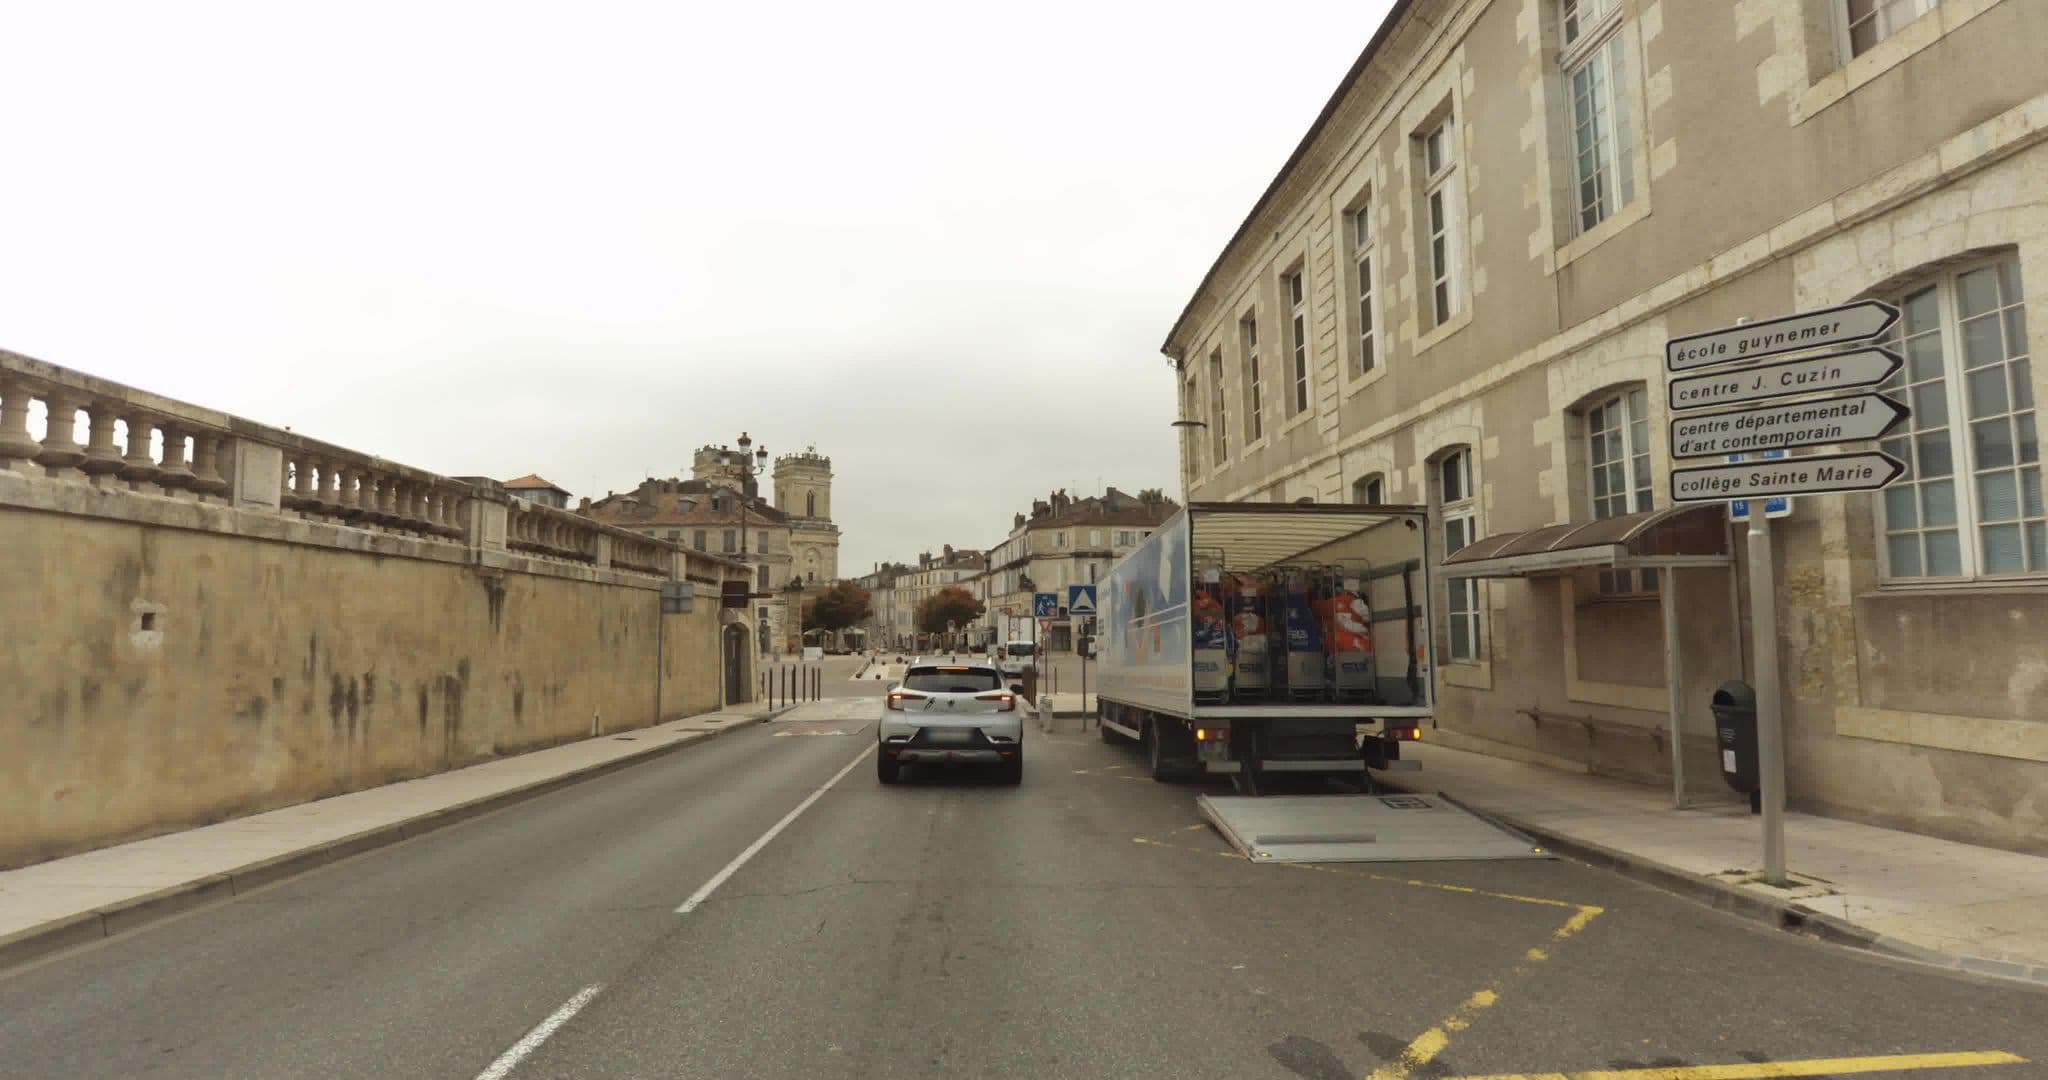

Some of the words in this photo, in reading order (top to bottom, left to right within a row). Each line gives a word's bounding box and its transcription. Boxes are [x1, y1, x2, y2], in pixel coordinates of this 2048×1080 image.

[1677, 341, 1727, 362] école
[1738, 321, 1841, 354] guynemer
[1680, 383, 1739, 401] centre
[1751, 375, 1767, 390] J.
[1780, 365, 1841, 386] Cuzin
[1679, 420, 1729, 436] centre
[1735, 399, 1867, 431] départemental
[1679, 439, 1716, 453] d'art
[1721, 423, 1842, 448] contemporain
[1681, 475, 1741, 492] collège
[1749, 471, 1809, 487] Sainte
[1816, 464, 1873, 482] Marie
